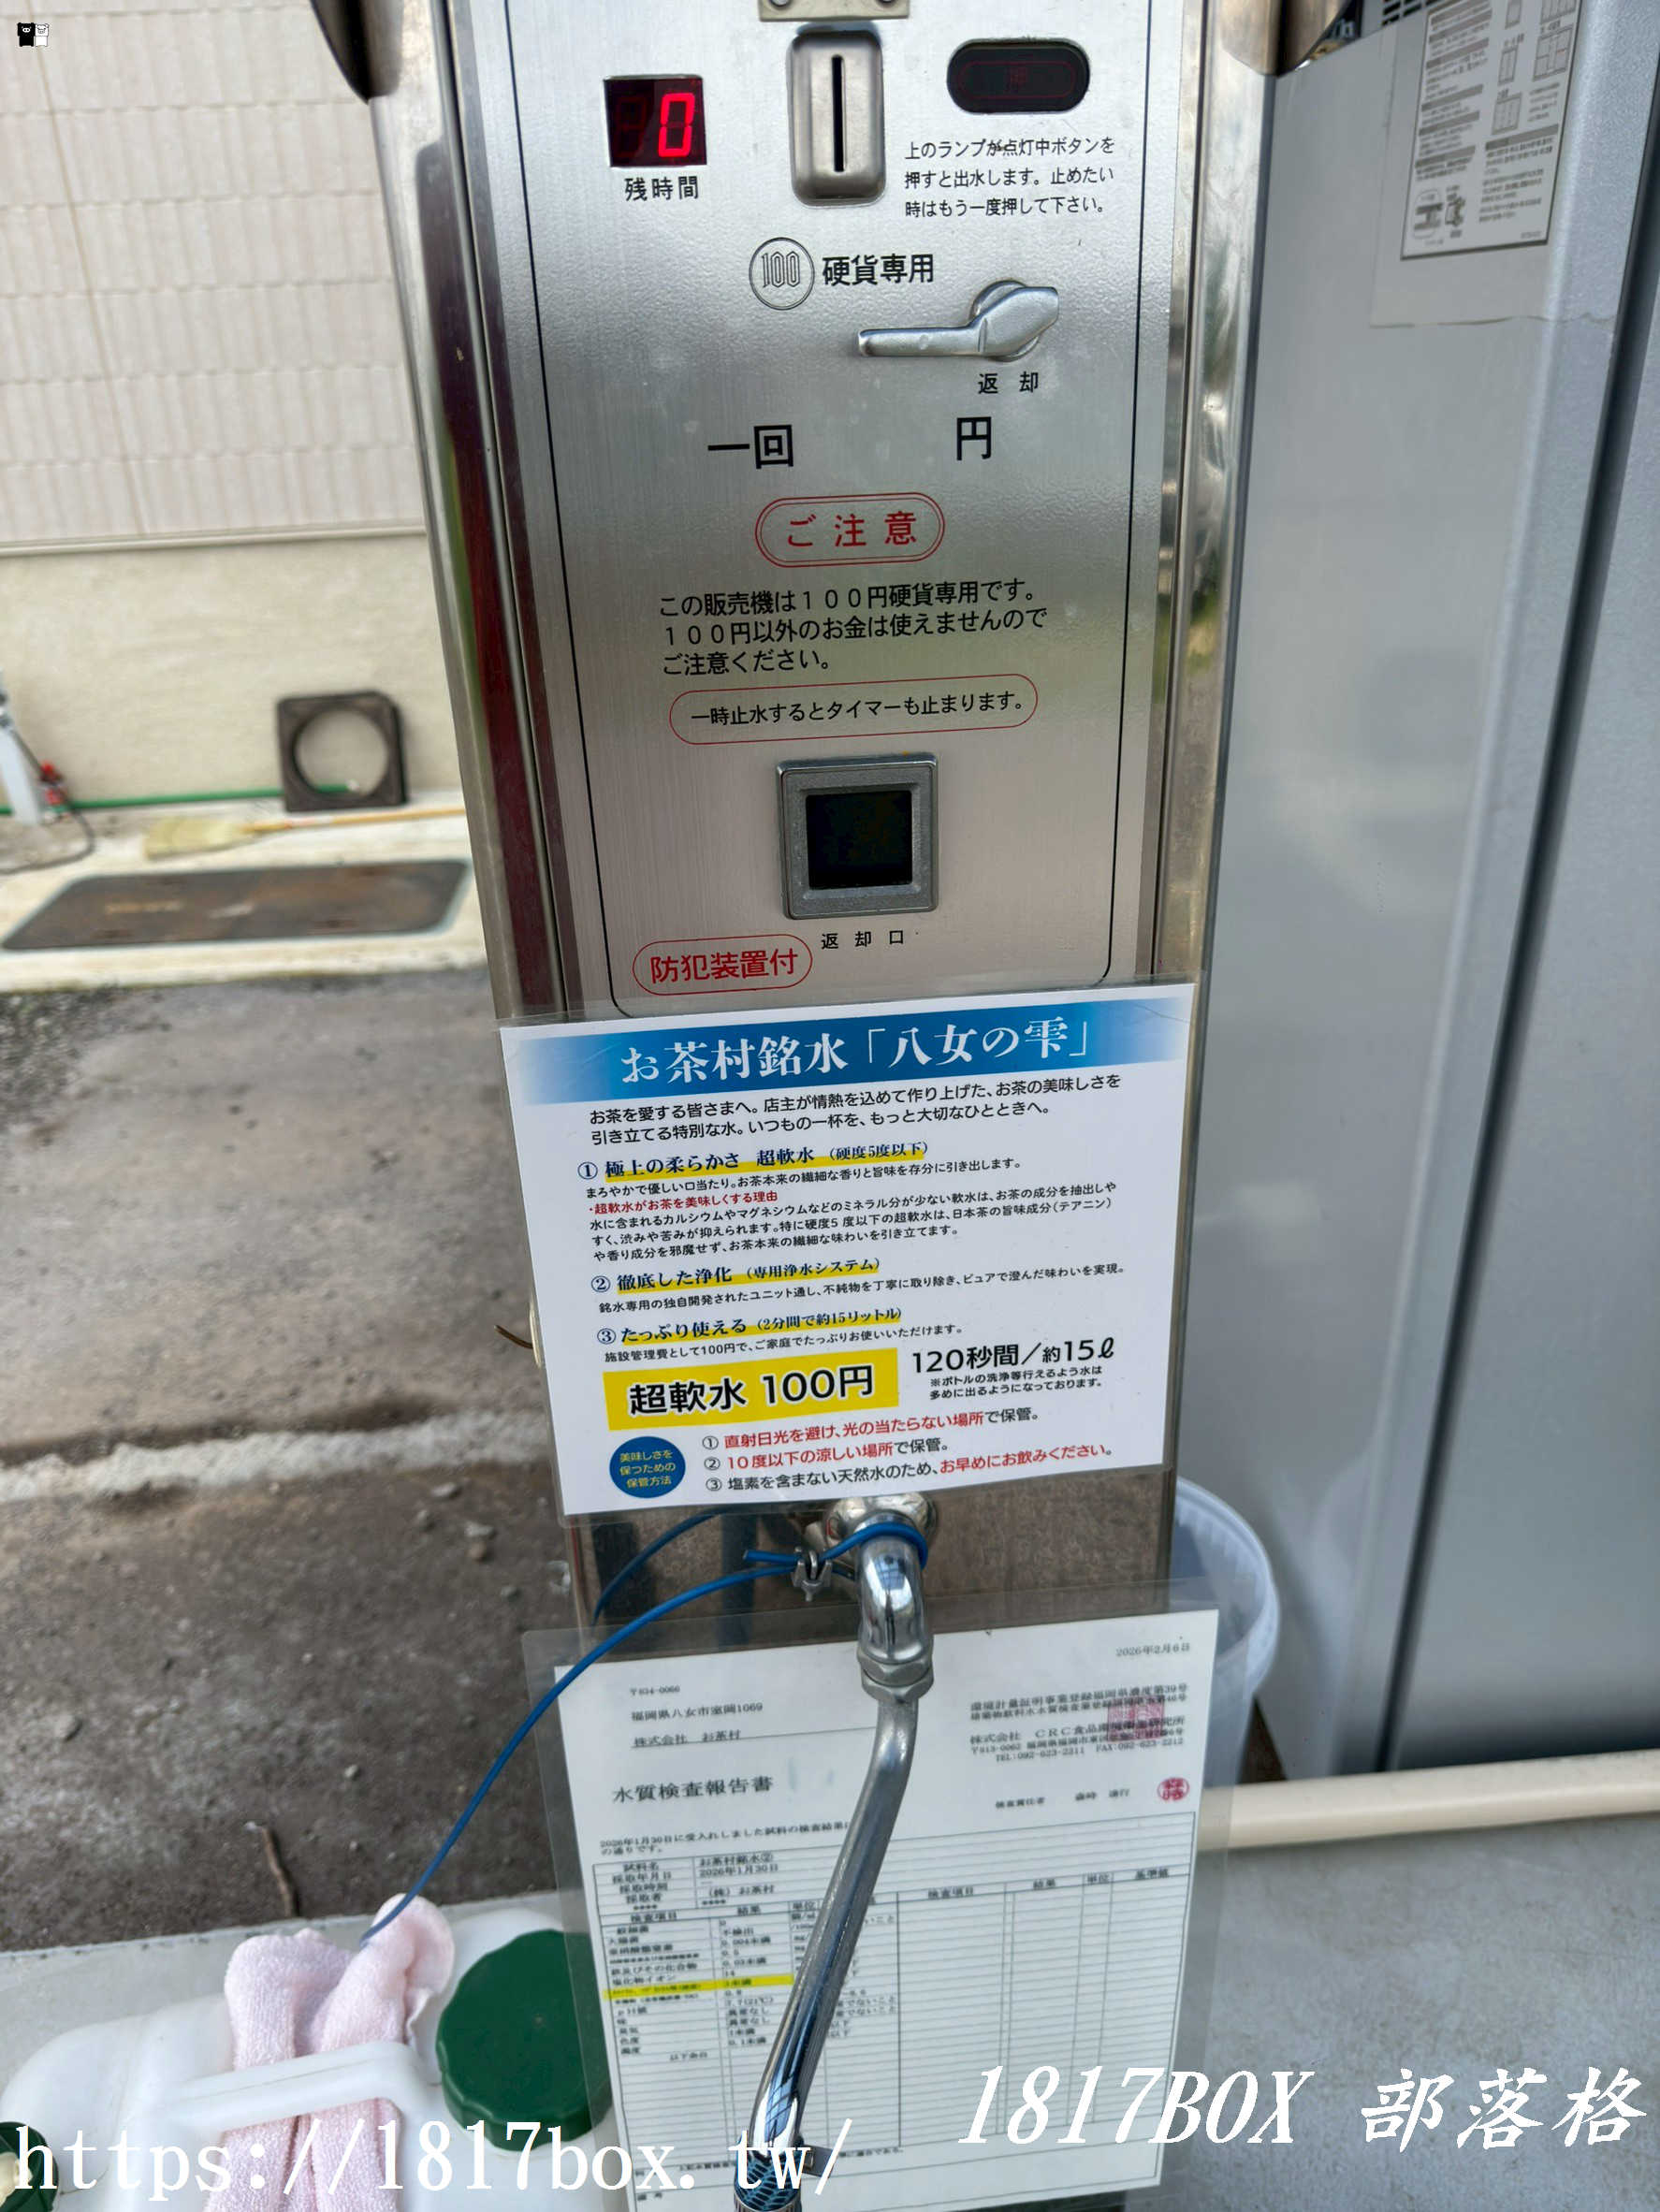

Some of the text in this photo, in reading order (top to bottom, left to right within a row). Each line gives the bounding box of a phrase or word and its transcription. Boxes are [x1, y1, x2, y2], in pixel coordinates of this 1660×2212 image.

[658, 92, 696, 158] 0
[904, 137, 1115, 160] 上のランプが点灯中ボタンを
[624, 175, 699, 201] 残時間
[904, 167, 1114, 189] 押すと出水します。止めたい
[905, 196, 1104, 218] 時はもう一度押して下さい。
[761, 251, 801, 288] 100
[822, 254, 935, 285] 硬貨専用
[978, 371, 1039, 394] 返却
[707, 416, 993, 469] 一回 円
[787, 511, 917, 547] ご注意
[663, 649, 830, 677] ご注意ください。
[692, 691, 1026, 726] 一時止水するとタイマーも止まります。
[821, 929, 904, 950] 返却口
[650, 948, 798, 983] 防犯装置付
[621, 1016, 1086, 1084] お茶村銘水「八女の雫」
[590, 1074, 1121, 1125] お茶を愛する皆さまへ。店主が情熱を込めて作り上げた、お茶の美味しさを
[590, 1101, 1049, 1146] 引き立てる特別な水。いつもの一杯を、もっと大切なひとときへ。
[605, 1151, 739, 1179] 極上の柔らかさ
[756, 1146, 814, 1167] 超軟水
[618, 1266, 733, 1291] 徹底した浄化
[620, 1317, 747, 1343] たっぷり使える
[630, 1364, 874, 1415] 超軟水 100円
[930, 1379, 1102, 1401] 多めに出るようになっております。
[724, 1406, 1039, 1449] 直射日光を避け、光の当たらない場所で保管。
[619, 1449, 673, 1463] 美味しさを
[619, 1463, 676, 1476] 保つための
[728, 1444, 1112, 1491] 塩素を含まない天然水のため、お早めにお飲みください。
[626, 1476, 672, 1489] 保管方法
[634, 1734, 688, 1747] 株式会社
[970, 1731, 1021, 1745] 株式会社
[613, 1775, 773, 1803] 水質検査報告書
